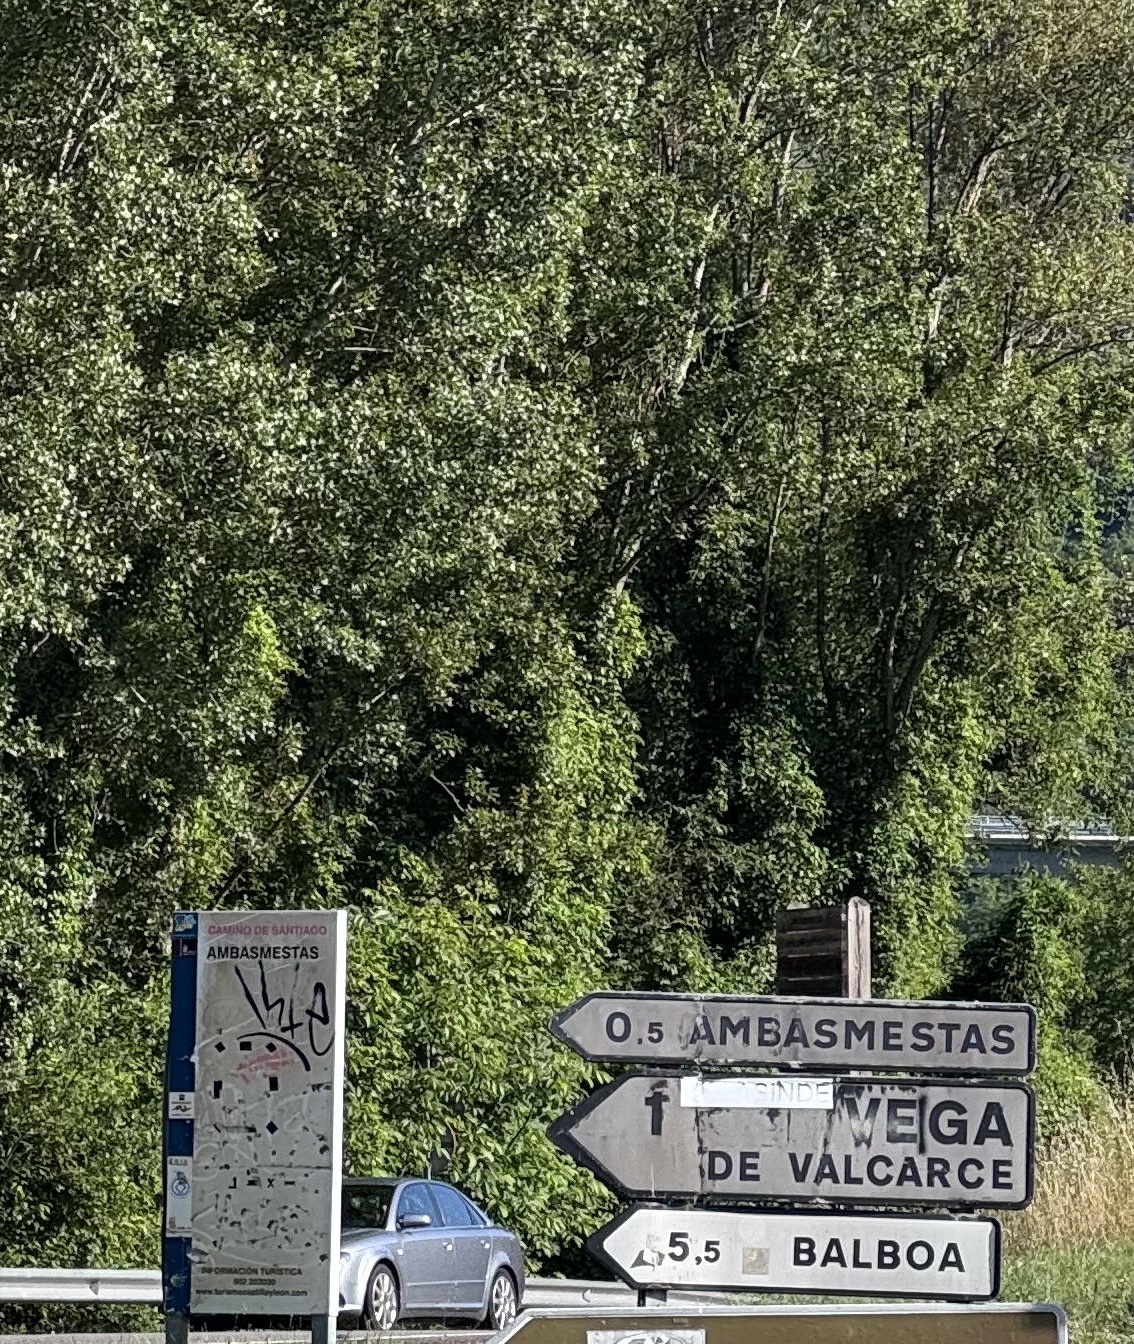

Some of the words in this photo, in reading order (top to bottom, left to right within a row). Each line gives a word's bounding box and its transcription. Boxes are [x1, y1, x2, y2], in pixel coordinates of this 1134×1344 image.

[208, 925, 251, 935] CAMINO
[254, 925, 269, 935] DE
[271, 925, 327, 936] SANTIAGO
[206, 946, 319, 960] AMBASMESTAS
[689, 1015, 1015, 1055] AMBASMESTAS
[844, 1097, 1014, 1148] VEGA
[708, 1150, 761, 1182] DE
[788, 1152, 1013, 1190] VALCARCE
[668, 1231, 721, 1267] 5,5
[793, 1236, 966, 1273] BALBOA
